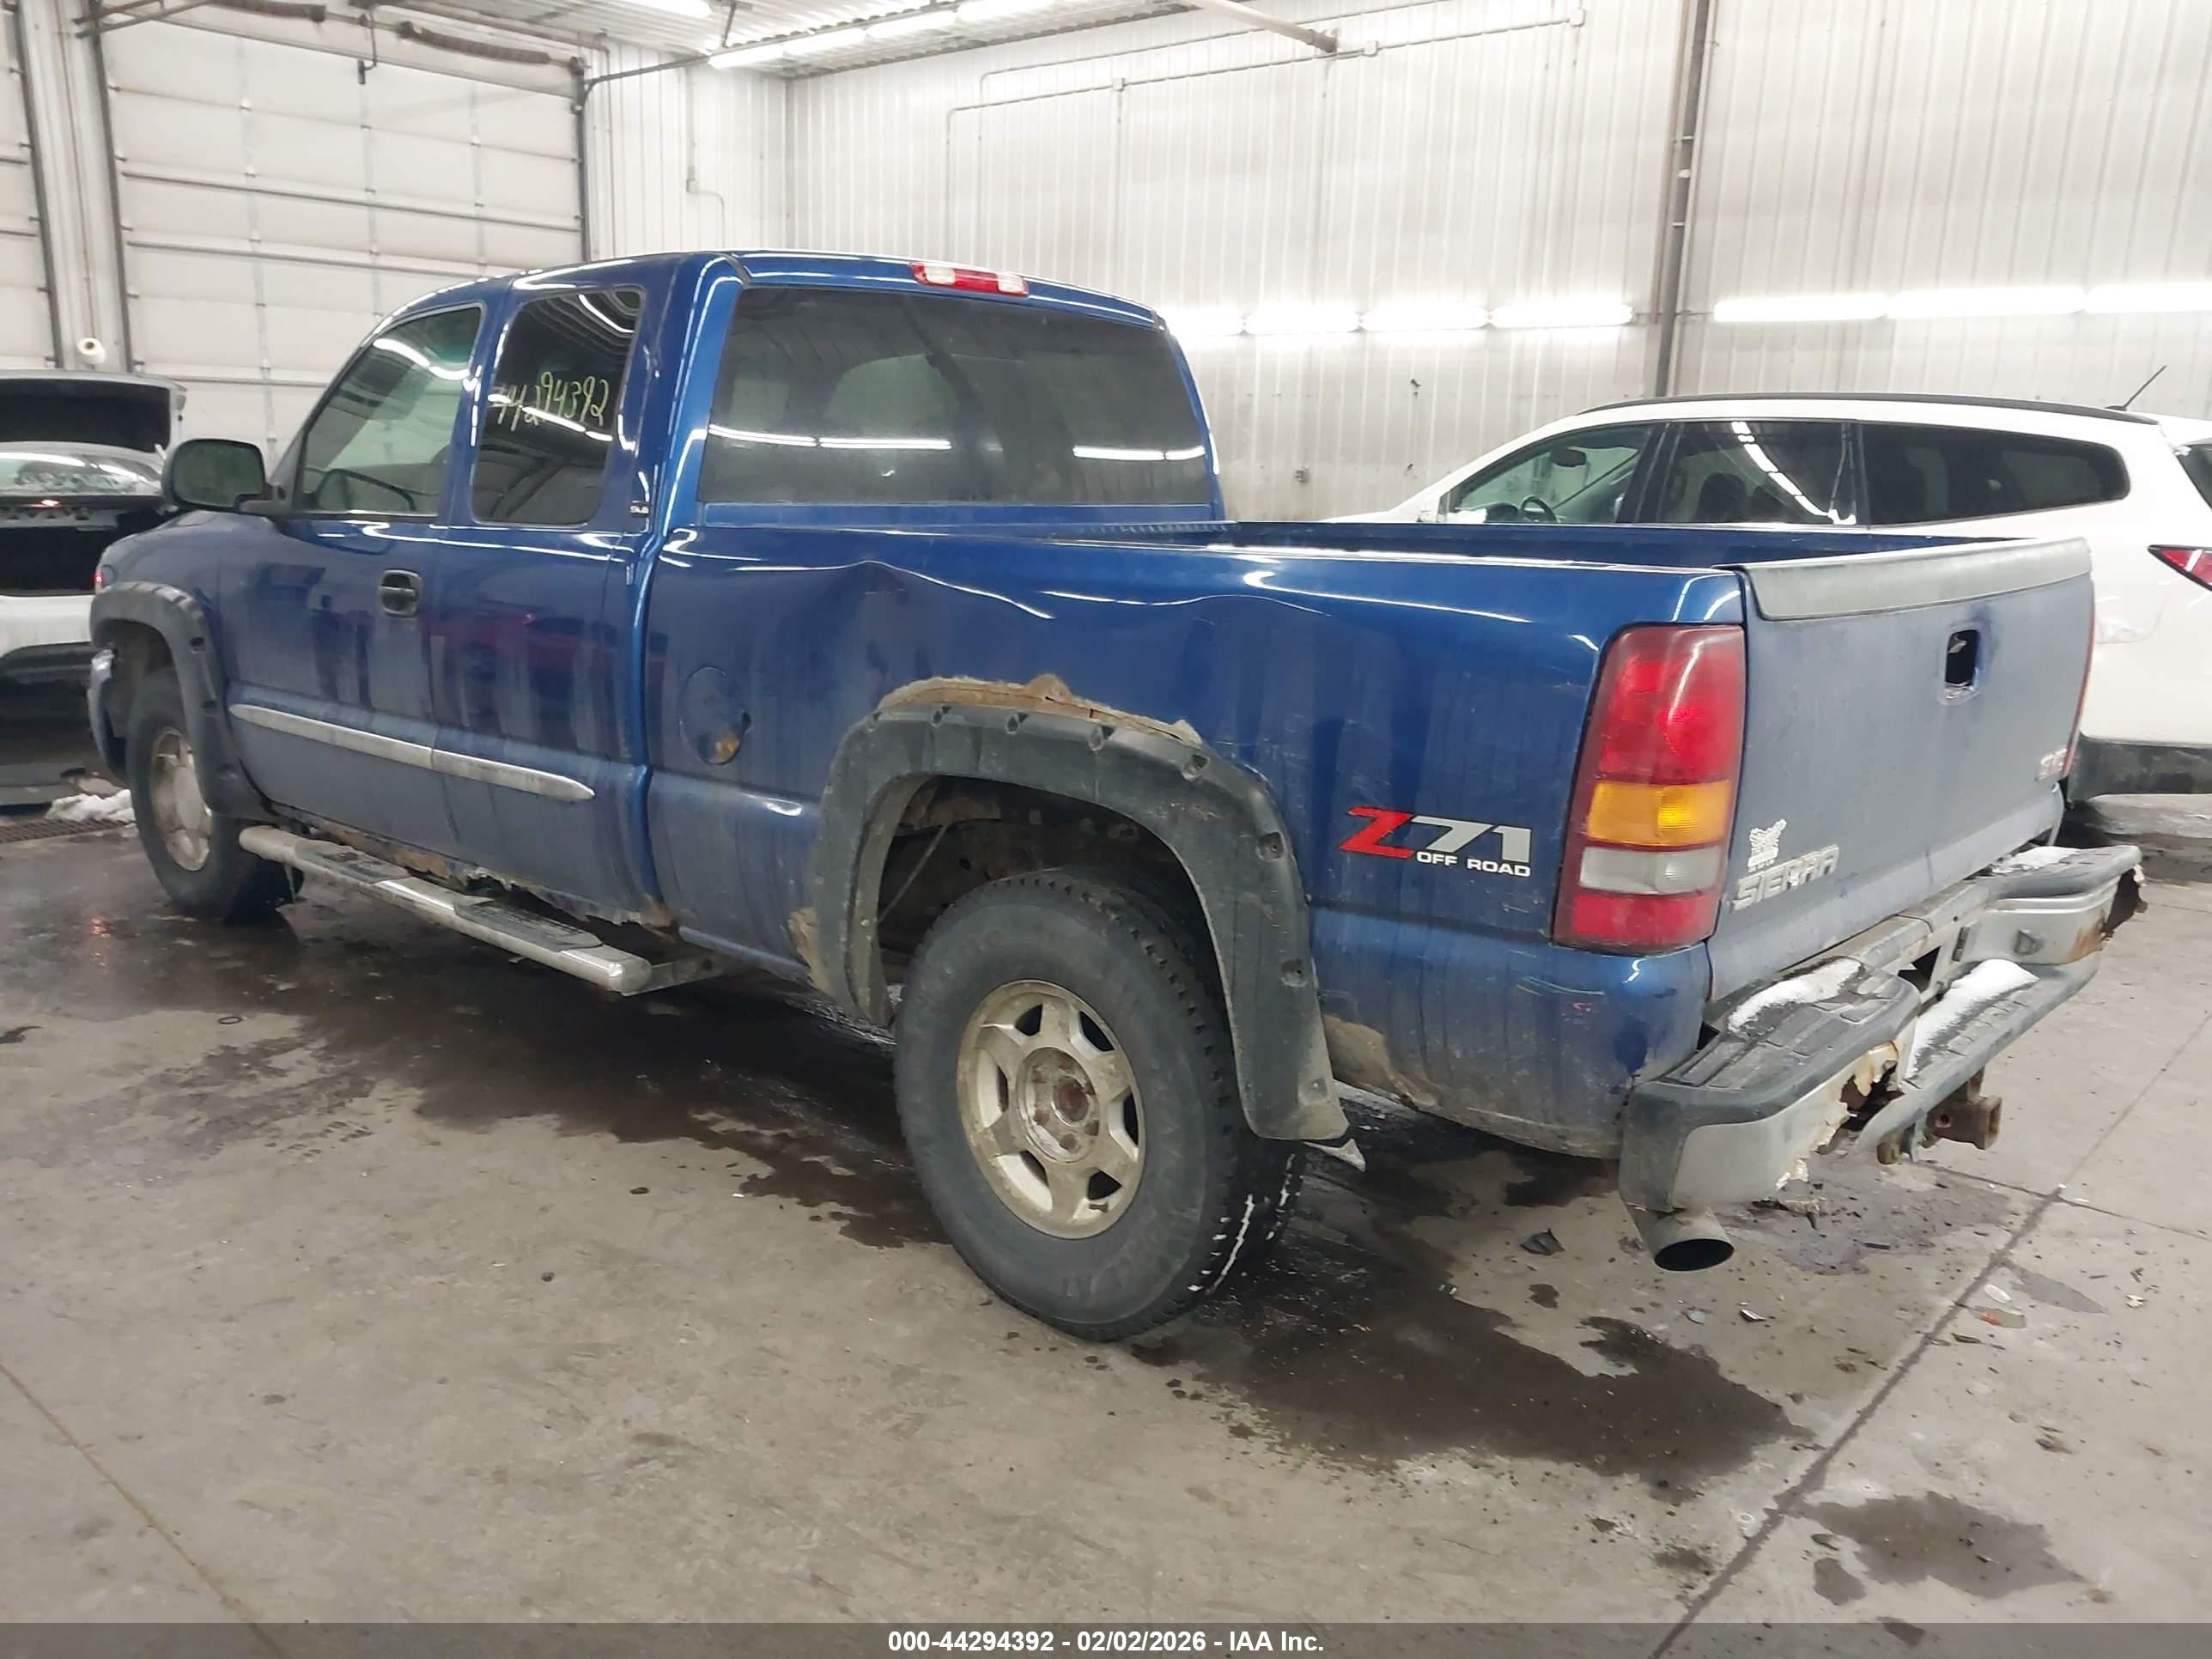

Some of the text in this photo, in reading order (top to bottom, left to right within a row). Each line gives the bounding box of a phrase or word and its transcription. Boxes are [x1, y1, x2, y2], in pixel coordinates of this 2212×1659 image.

[1339, 805, 1532, 863] Z71
[1417, 851, 1531, 878] OFF ROAD
